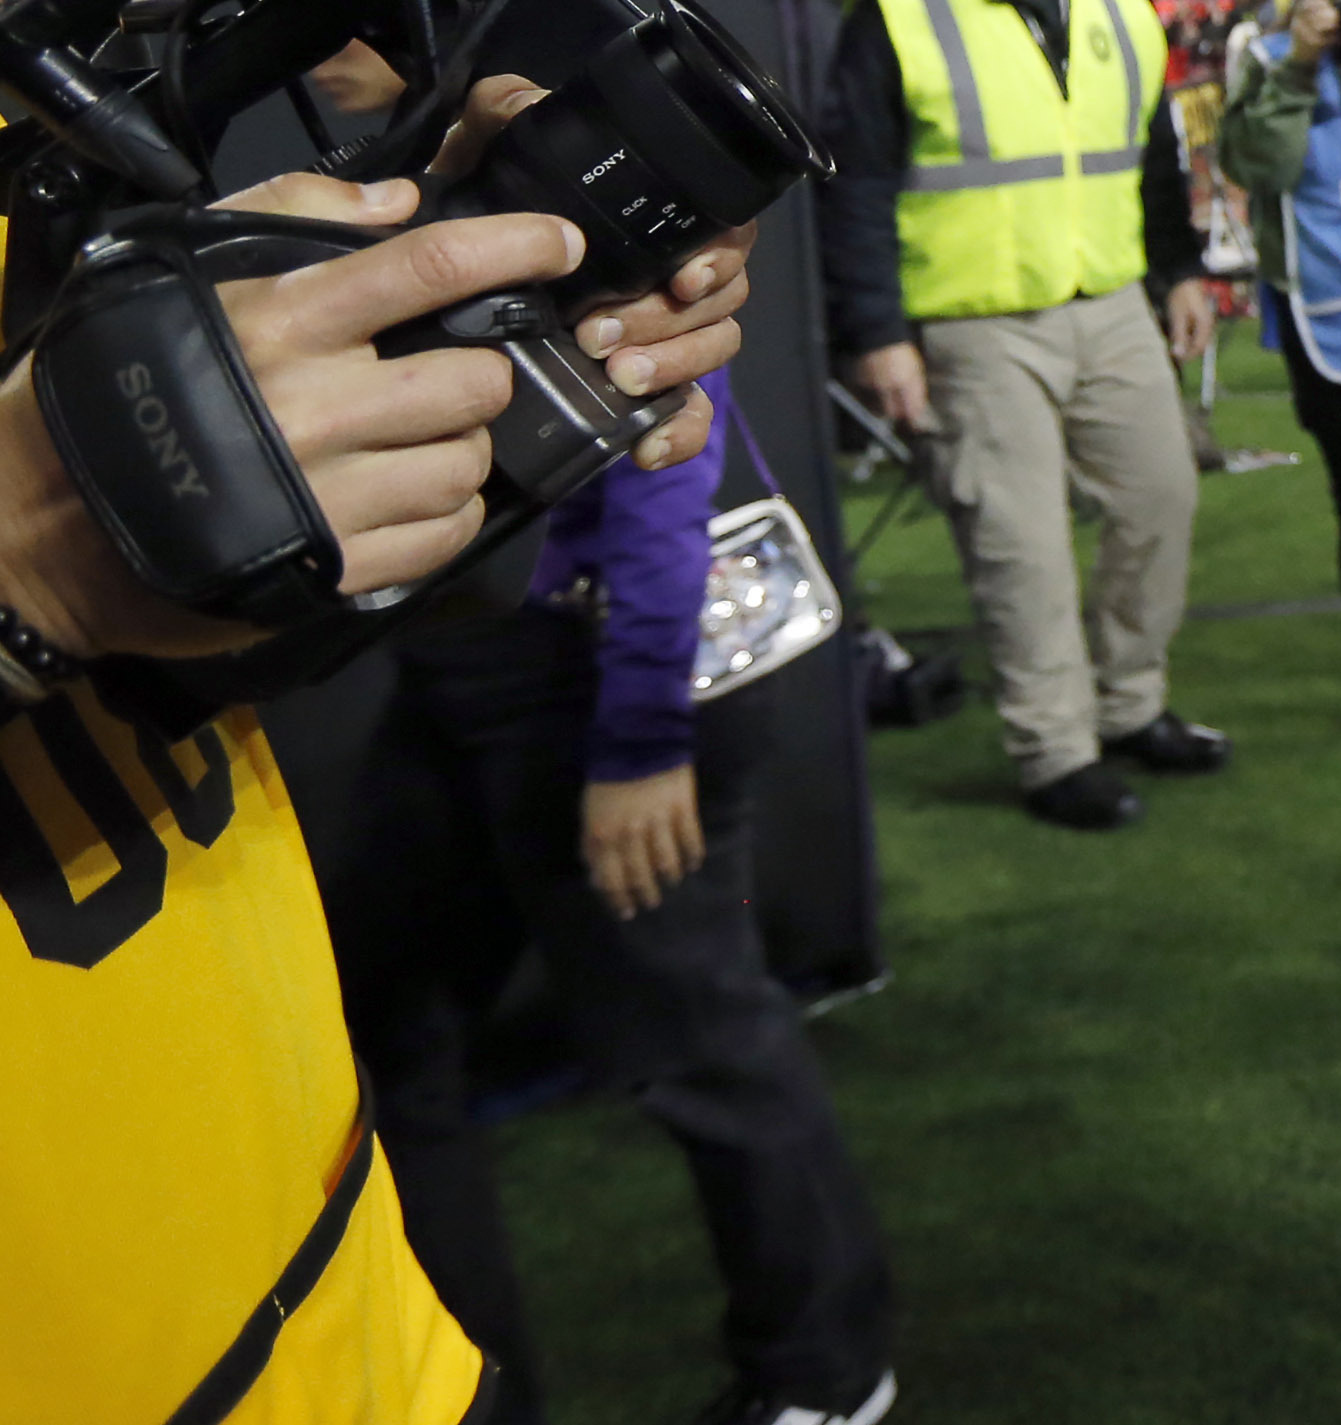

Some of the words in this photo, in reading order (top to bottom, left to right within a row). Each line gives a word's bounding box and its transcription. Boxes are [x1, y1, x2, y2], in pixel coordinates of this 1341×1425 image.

[582, 148, 627, 185] SONY
[622, 195, 648, 216] CLICK
[662, 202, 677, 214] ON
[115, 360, 212, 501] SONY
